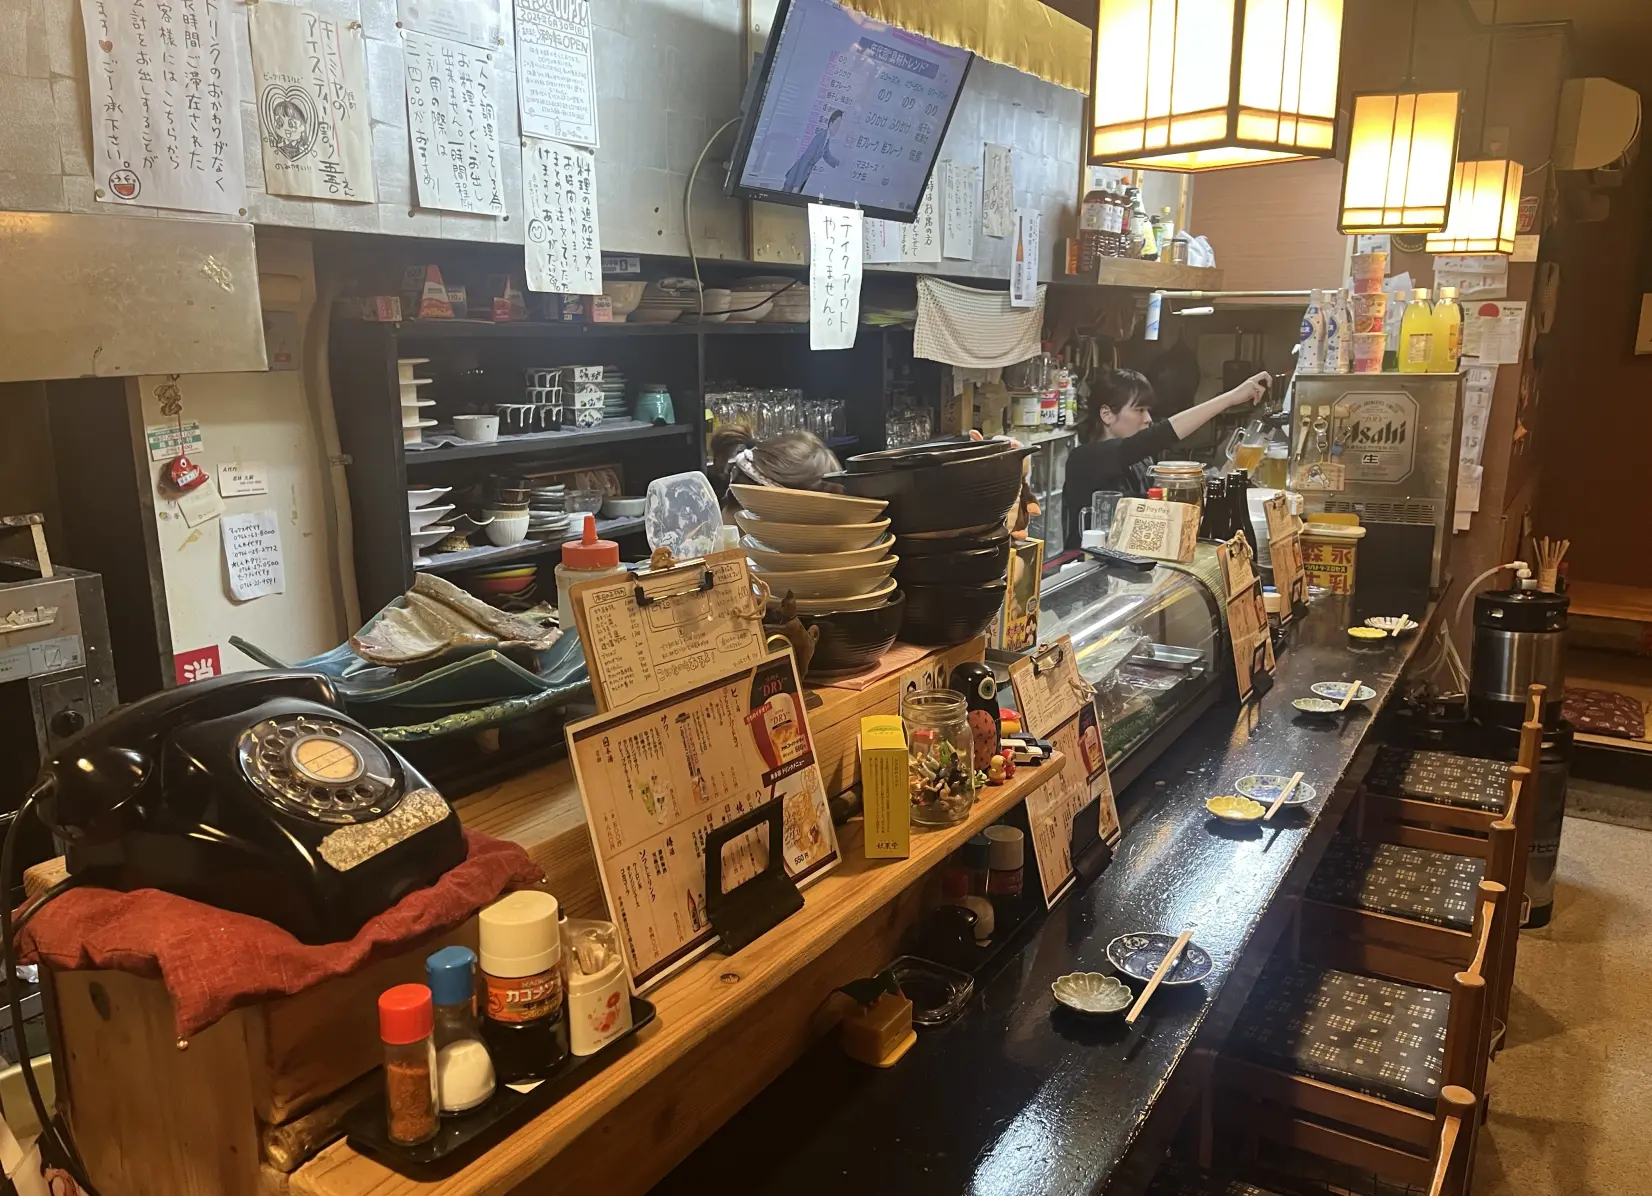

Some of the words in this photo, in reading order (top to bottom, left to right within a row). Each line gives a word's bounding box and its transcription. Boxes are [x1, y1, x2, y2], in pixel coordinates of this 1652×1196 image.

[877, 89, 892, 102] のり
[901, 96, 916, 109] のり
[924, 104, 939, 116] のり
[822, 216, 836, 326] やってません。
[840, 216, 852, 332] テイクアウト
[1346, 421, 1407, 444] Asahi
[1363, 454, 1379, 464] 生
[1146, 505, 1171, 514] PayPay
[763, 679, 783, 696] DRY
[773, 712, 787, 724] DRY
